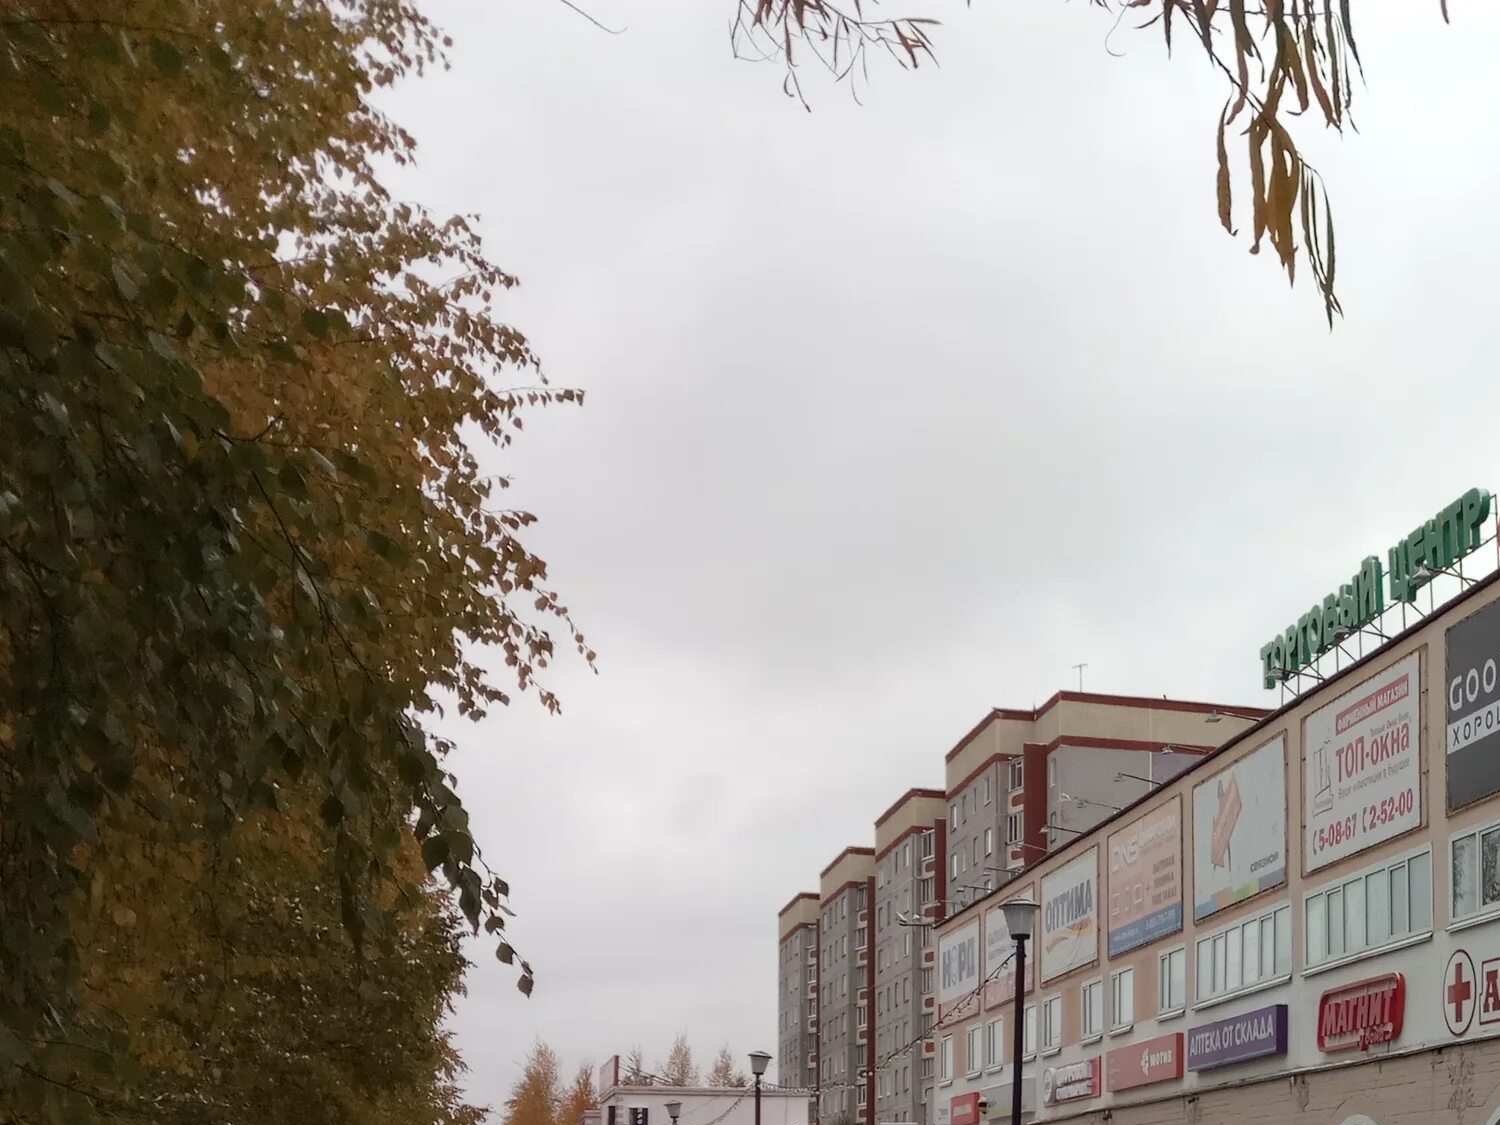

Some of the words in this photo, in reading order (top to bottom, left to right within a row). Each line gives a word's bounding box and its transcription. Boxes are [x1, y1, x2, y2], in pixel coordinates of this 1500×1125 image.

[1260, 555, 1384, 690] ТОРГОВЫЙ
[1388, 487, 1491, 602] ЦЕНТР
[1318, 812, 1357, 851] 5-08-67
[1369, 788, 1414, 830] 2-52-00
[1112, 834, 1138, 873] DNS
[1045, 879, 1093, 934] ОПТИМА
[1189, 1029, 1221, 1056] АПТЕКА
[1222, 1024, 1234, 1049] ОТ
[1235, 1014, 1274, 1046] СКЛАДА
[1321, 988, 1395, 1037] МАГНИТ
